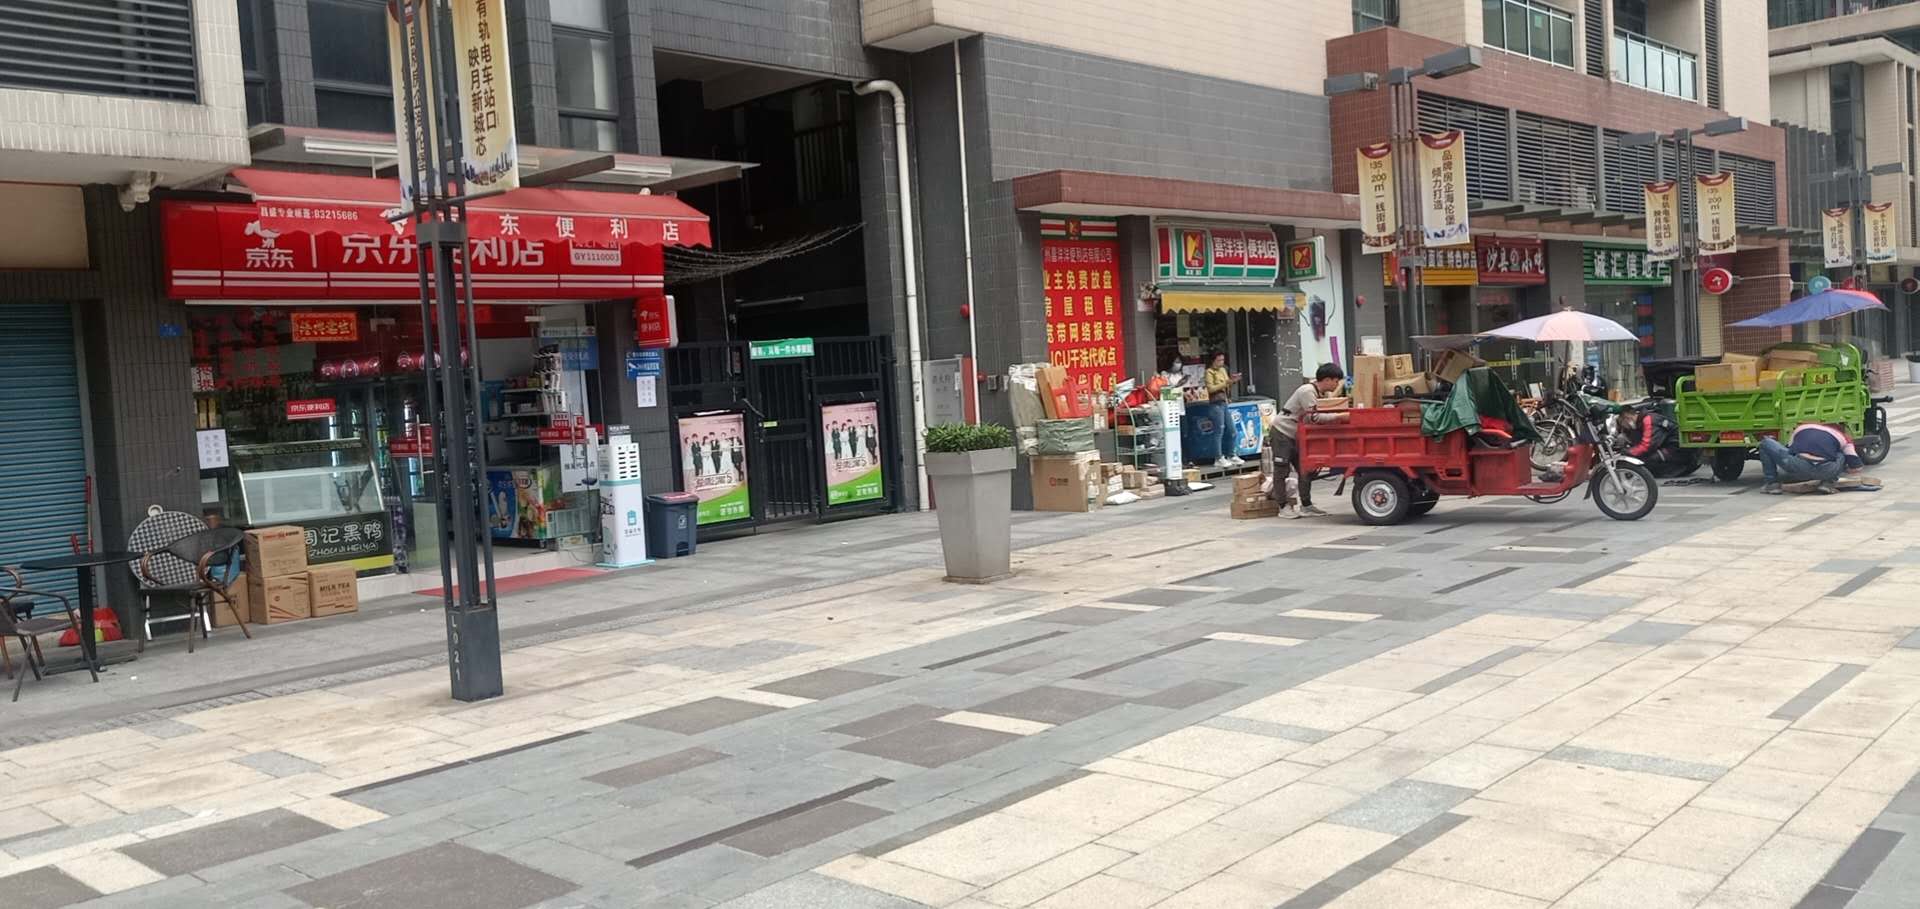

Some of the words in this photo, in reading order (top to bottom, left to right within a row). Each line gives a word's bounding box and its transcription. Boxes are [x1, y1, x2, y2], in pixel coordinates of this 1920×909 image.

[475, 0, 497, 131] 有轨电车站口
[469, 47, 487, 156] 映月新城芯
[245, 248, 293, 268] 京东
[341, 233, 545, 267] 京东利店
[1043, 269, 1112, 290] 业主免费放盘
[1044, 295, 1113, 317] 房屋租售
[1046, 320, 1115, 343] 宽带网络报装
[304, 521, 384, 547] 周记黑鸭
[320, 584, 336, 592] MILK
[338, 582, 350, 590] TEA
[451, 615, 460, 681] L021
